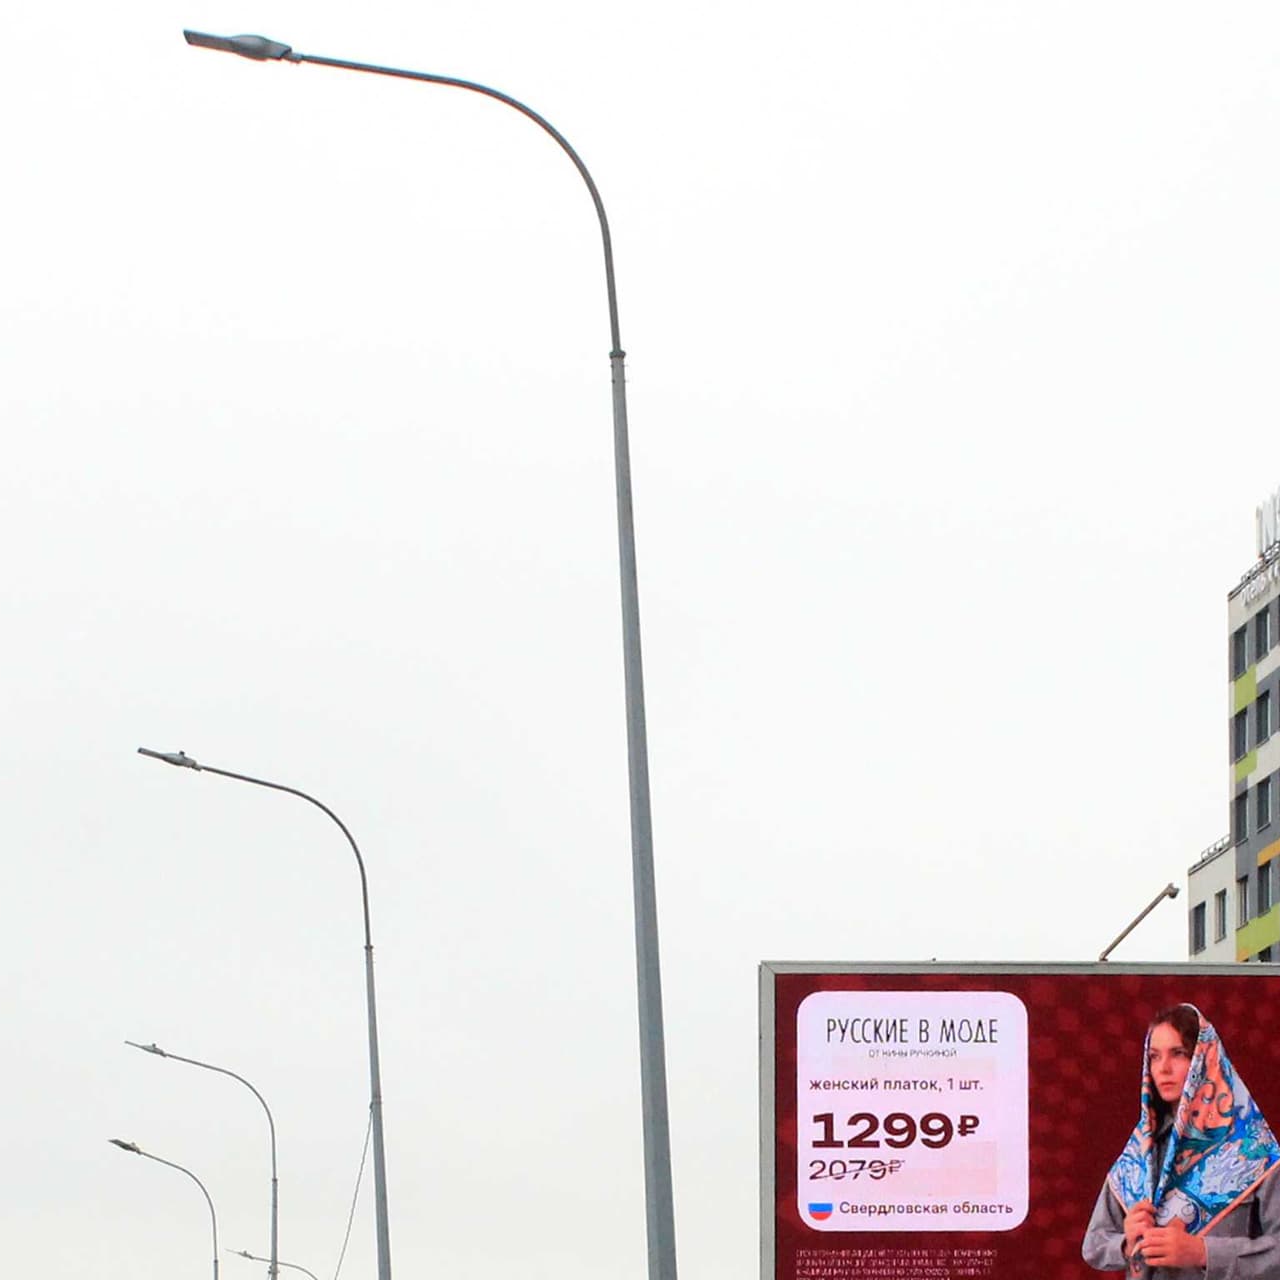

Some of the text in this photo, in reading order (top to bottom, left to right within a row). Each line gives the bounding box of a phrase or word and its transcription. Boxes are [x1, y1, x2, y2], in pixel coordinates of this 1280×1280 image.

[826, 1018, 999, 1044] РУССКИЕ В МОДЕ
[809, 1077, 984, 1093] женский платок, 1 шт.
[839, 1201, 1014, 1217] Свердловская область
